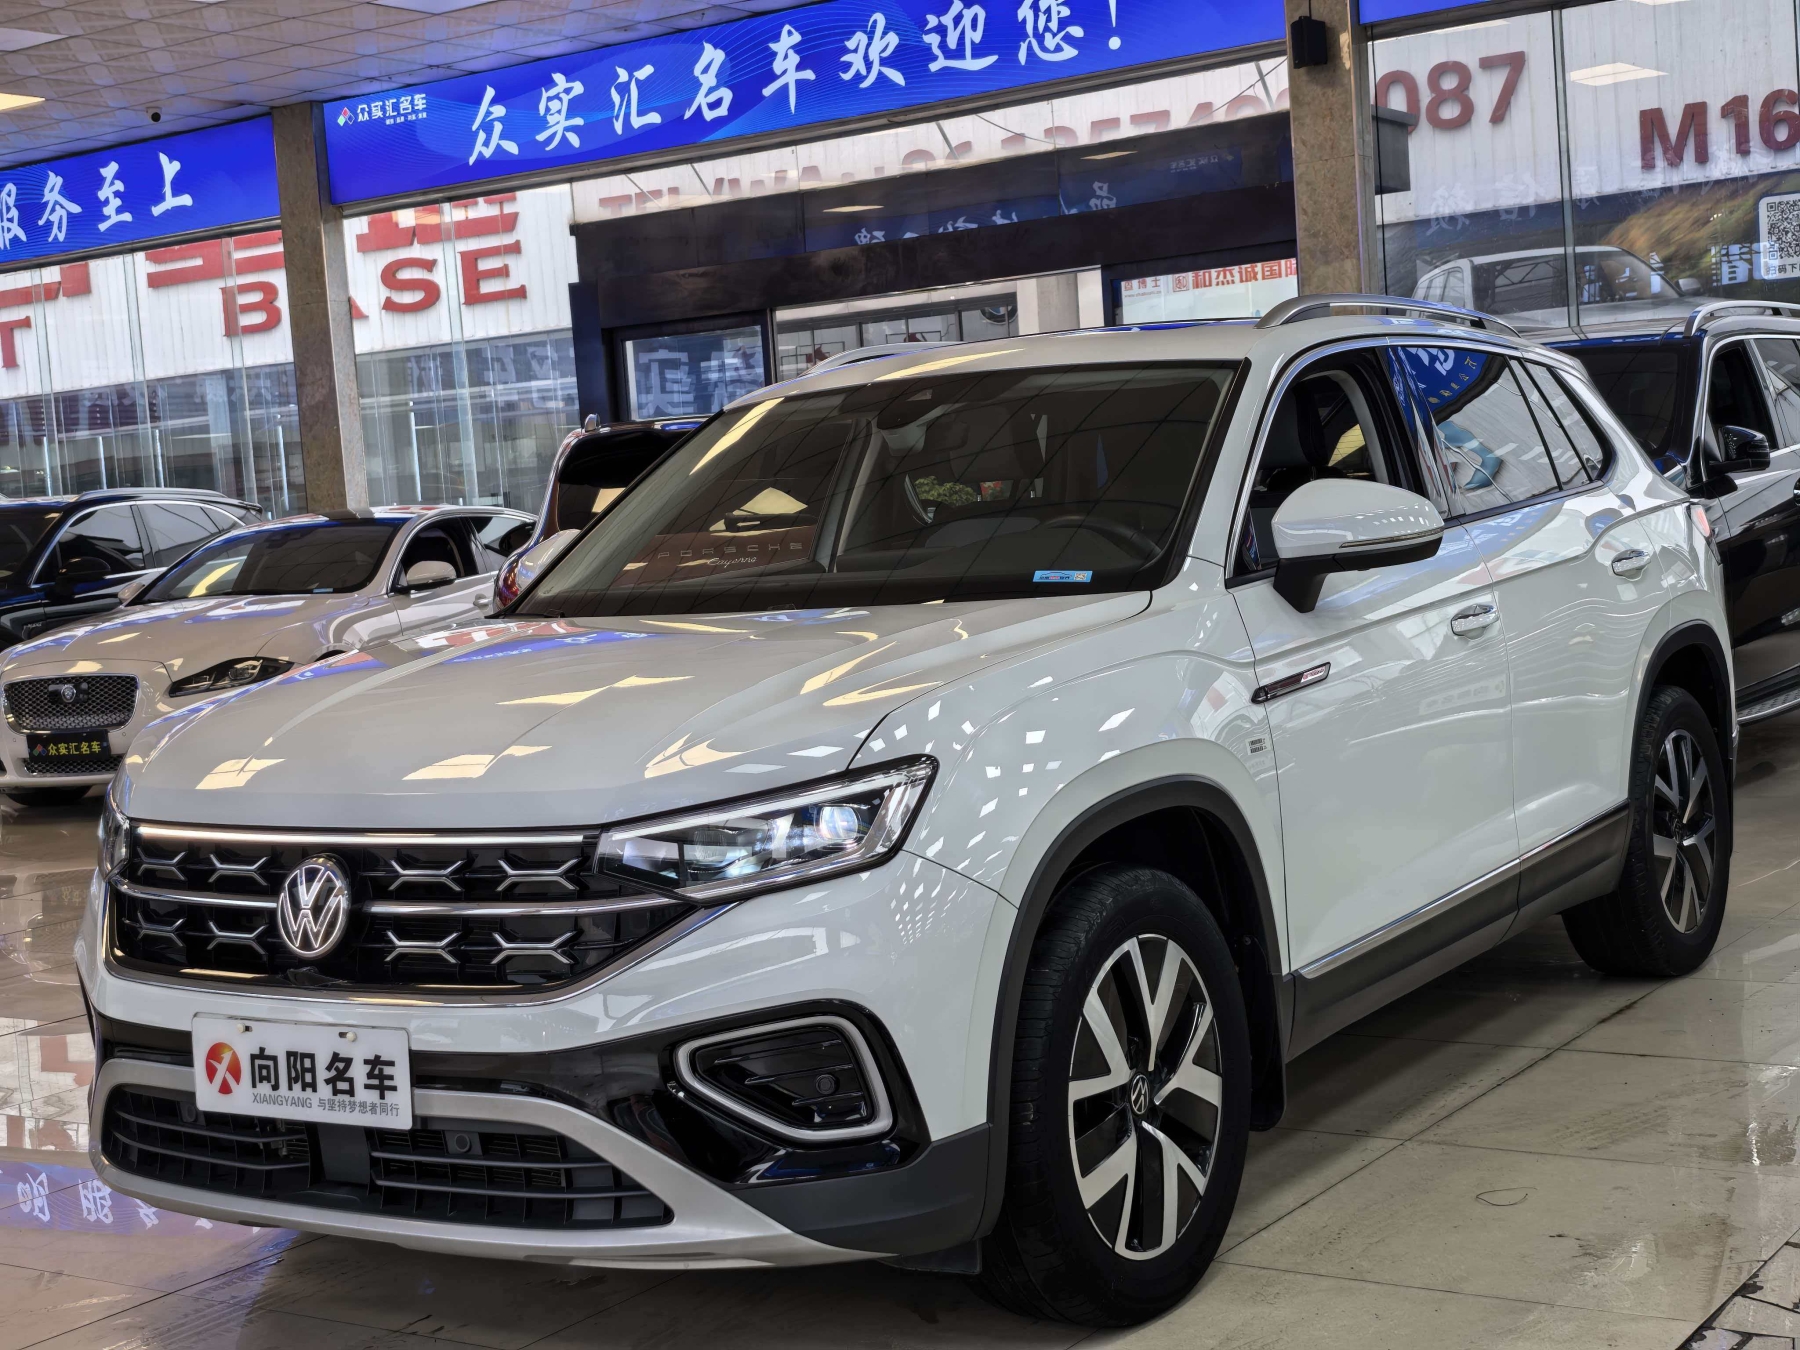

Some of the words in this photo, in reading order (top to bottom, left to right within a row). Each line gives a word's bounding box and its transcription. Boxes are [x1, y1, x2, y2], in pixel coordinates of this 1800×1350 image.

[357, 94, 427, 122] 众实汇名车
[0, 152, 193, 249] 服务至上
[1767, 263, 1800, 275] 扫码下
[219, 239, 527, 337] BSE
[48, 741, 102, 755] 众实汇名车
[250, 1047, 398, 1100] 向阳名车
[252, 1092, 313, 1109] XIANGYANG
[317, 1097, 400, 1117] 与坚持梦想者同行
